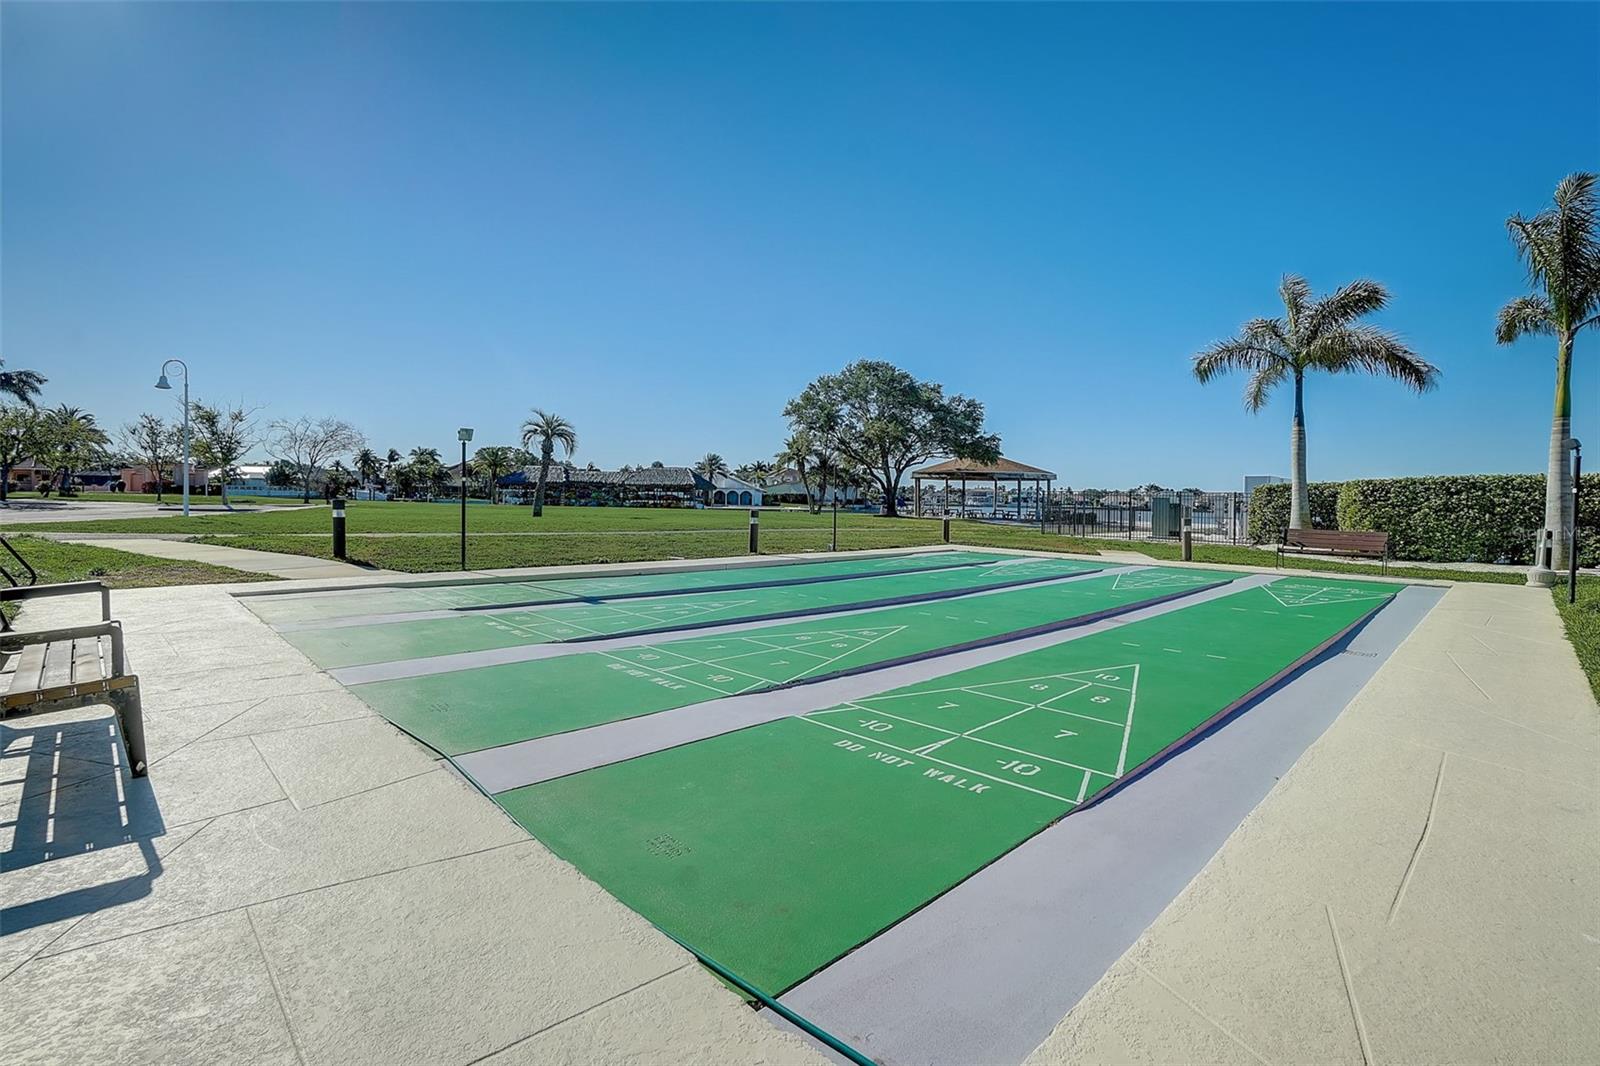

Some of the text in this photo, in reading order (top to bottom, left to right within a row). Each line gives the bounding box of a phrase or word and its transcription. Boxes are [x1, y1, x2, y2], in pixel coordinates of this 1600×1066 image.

[1095, 673, 1120, 681] 10
[1090, 695, 1111, 704] 8
[937, 701, 960, 709] 7
[858, 718, 893, 732] -10
[1054, 729, 1078, 739] 7
[832, 739, 991, 794] DO NOT WALK
[996, 759, 1041, 776] -10
